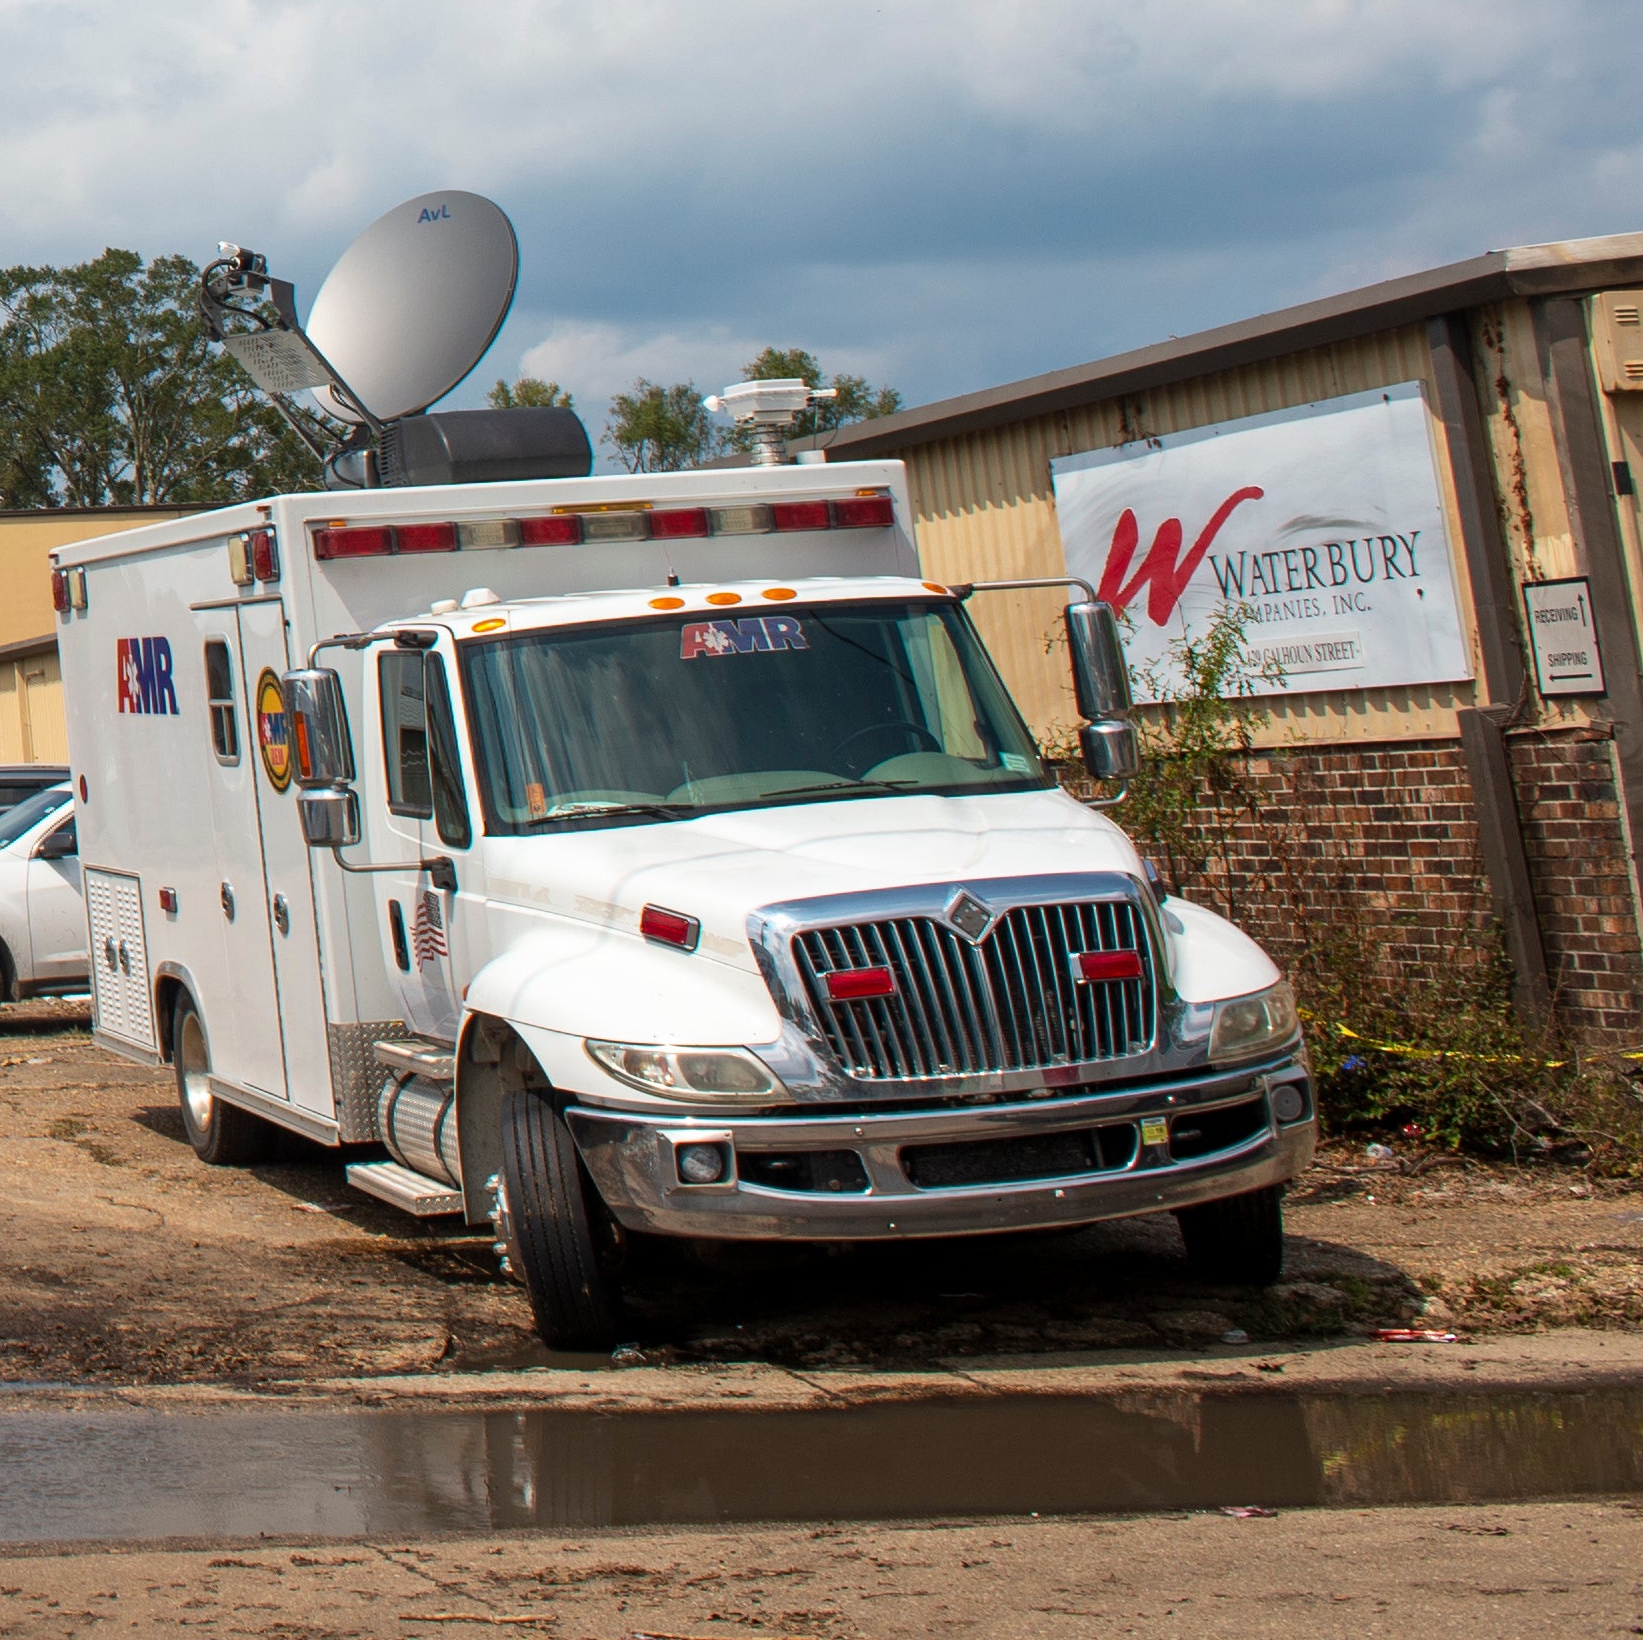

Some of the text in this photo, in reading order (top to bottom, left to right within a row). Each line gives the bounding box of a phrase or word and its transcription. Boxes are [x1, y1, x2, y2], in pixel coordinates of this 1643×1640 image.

[1207, 531, 1420, 600] WATERBURY
[1332, 591, 1372, 615] INC.
[1534, 606, 1579, 624] RECEIVING
[680, 616, 810, 659] AMR
[1314, 640, 1355, 662] STREET
[1547, 651, 1588, 667] SHIPPING
[117, 636, 180, 715] AMR
